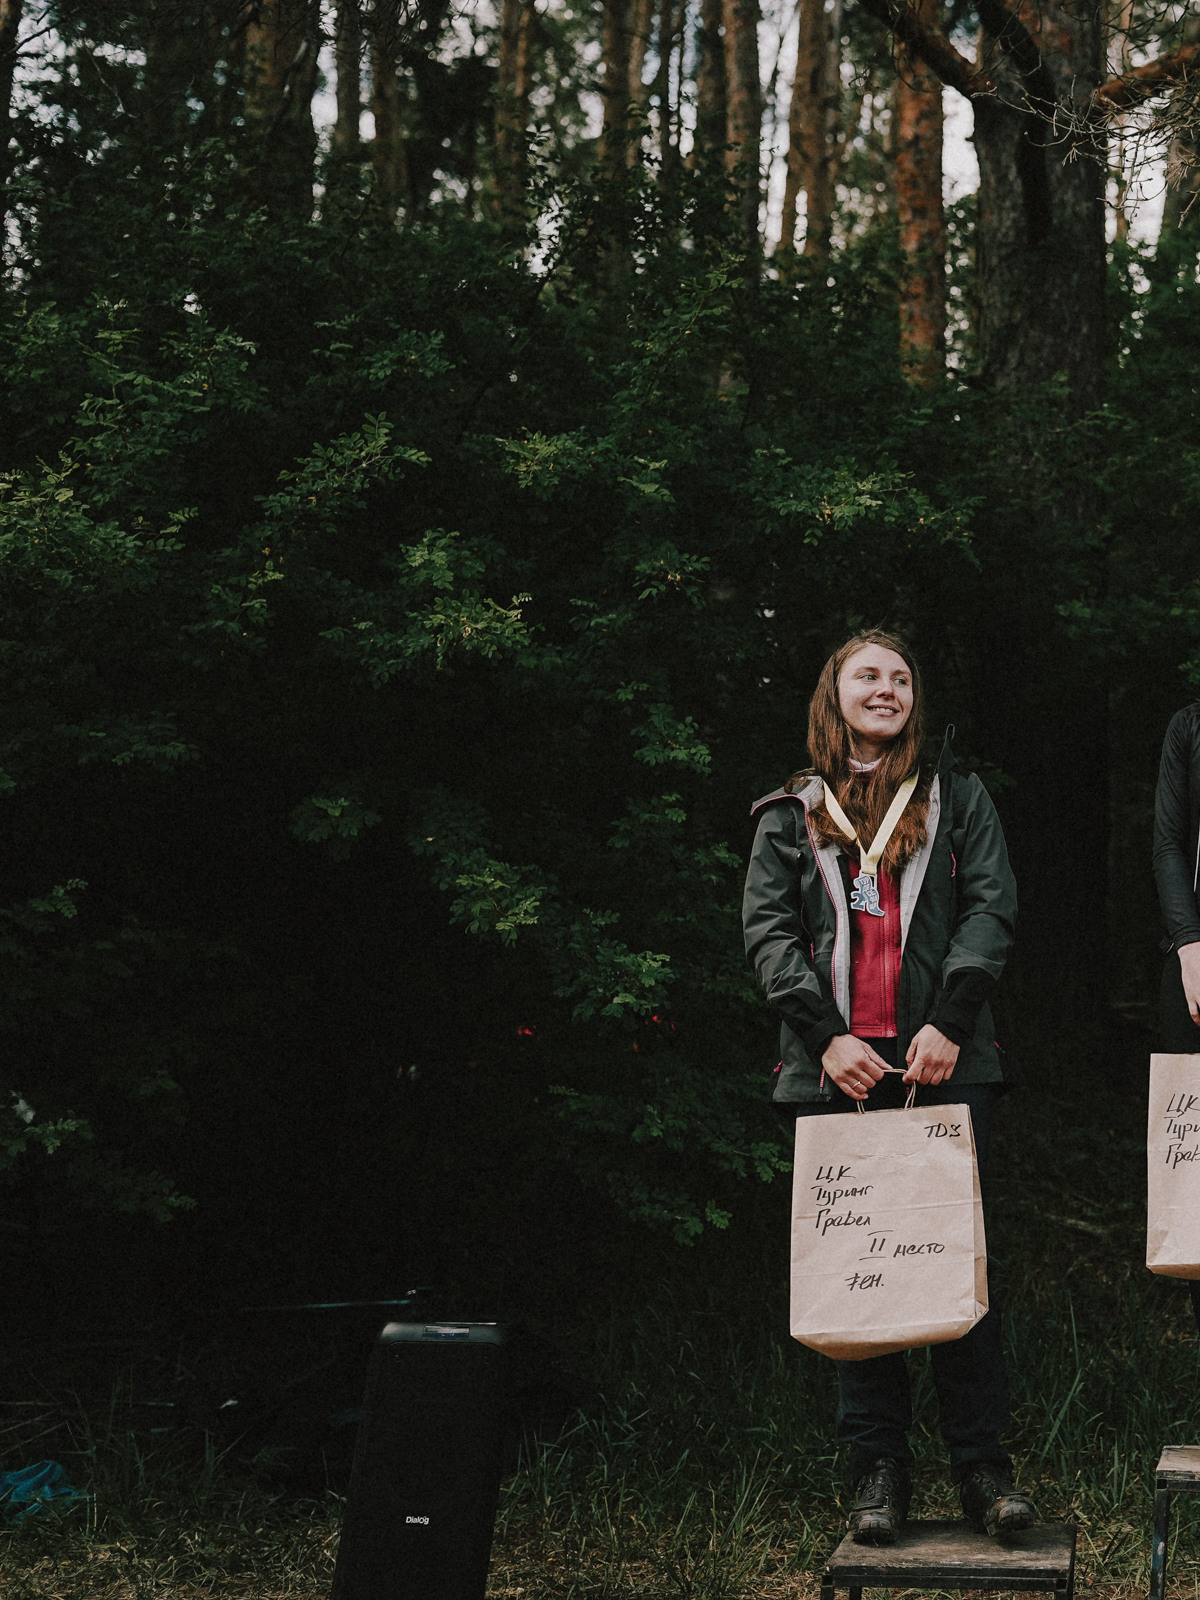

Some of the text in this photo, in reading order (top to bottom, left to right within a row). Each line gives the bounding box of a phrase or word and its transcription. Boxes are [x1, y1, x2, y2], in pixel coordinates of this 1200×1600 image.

[853, 892, 864, 909] 2
[924, 1123, 962, 1138] TDS
[815, 1165, 856, 1184] ЦК
[893, 1243, 945, 1258] место
[405, 1516, 430, 1525] Dialog
